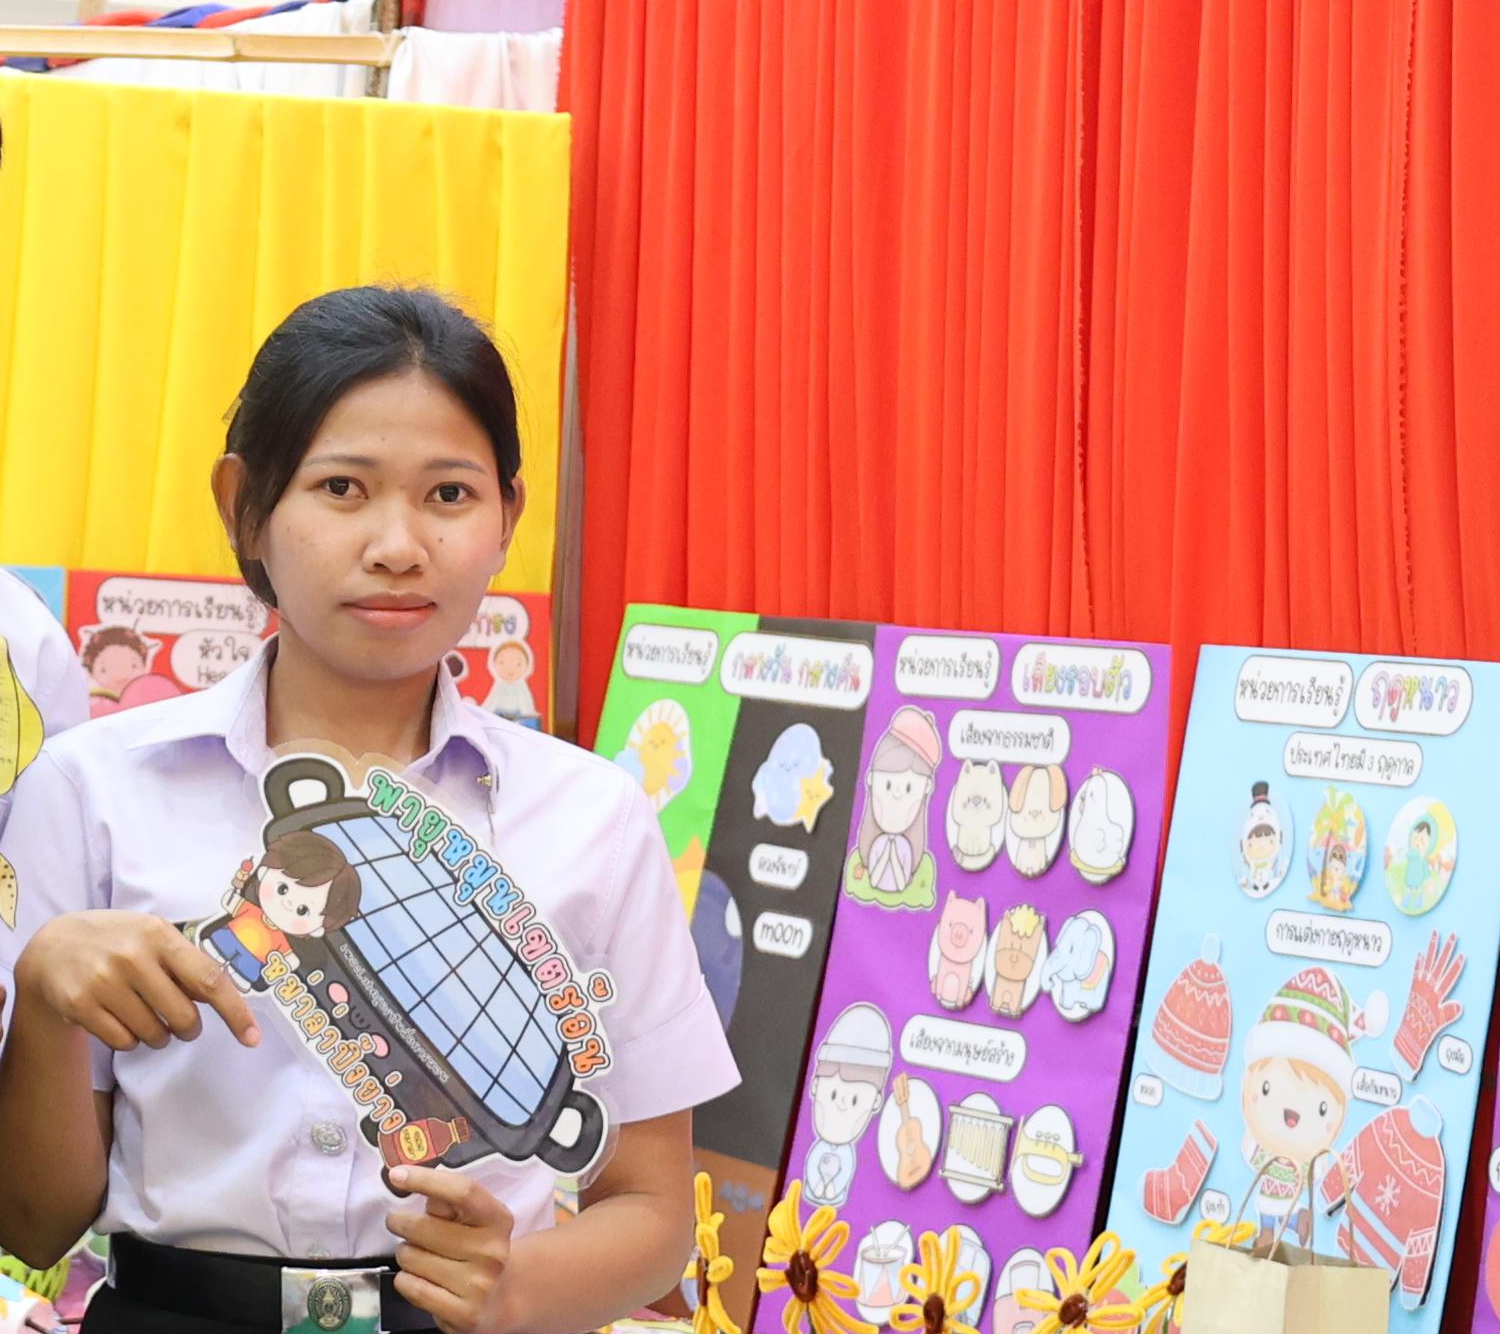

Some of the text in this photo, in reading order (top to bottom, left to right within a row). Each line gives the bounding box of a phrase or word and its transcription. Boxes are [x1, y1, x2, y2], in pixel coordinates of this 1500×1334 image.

[624, 634, 717, 681] หน่วยการเรียนรู้
[898, 647, 994, 690] หน่วยการเรียนรู้
[1239, 673, 1346, 719] หน่วยการเรียนรู้
[367, 768, 615, 1079] พายุหมุนเขตร้อน
